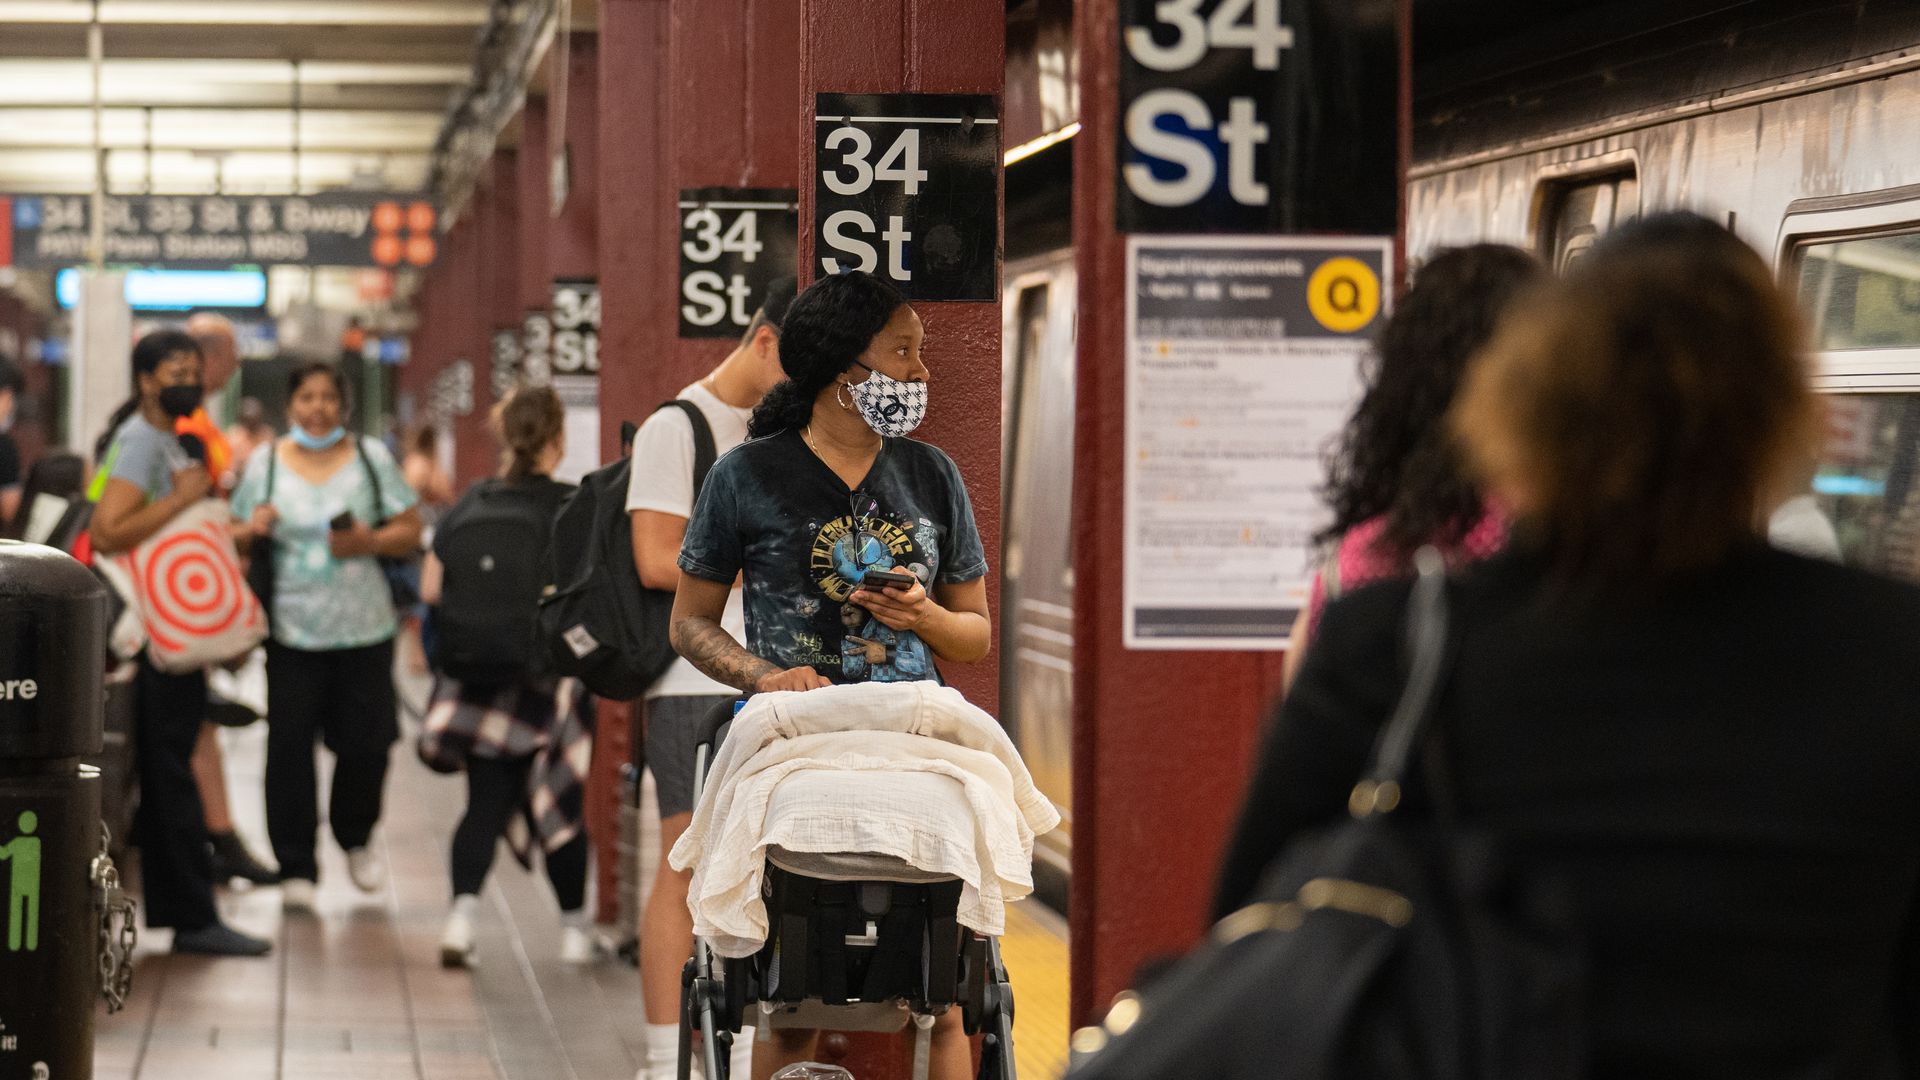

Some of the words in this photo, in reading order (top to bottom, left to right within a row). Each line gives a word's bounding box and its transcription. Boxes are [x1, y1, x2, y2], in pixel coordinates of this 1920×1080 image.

[1124, 0, 1294, 71] 34
[823, 127, 927, 195] 34
[1122, 88, 1269, 207] St
[44, 198, 83, 232] 34
[682, 209, 763, 262] 34
[822, 210, 911, 280] St
[553, 289, 600, 328] 34
[682, 270, 751, 325] St
[1328, 276, 1362, 314] Q
[553, 330, 600, 371] St
